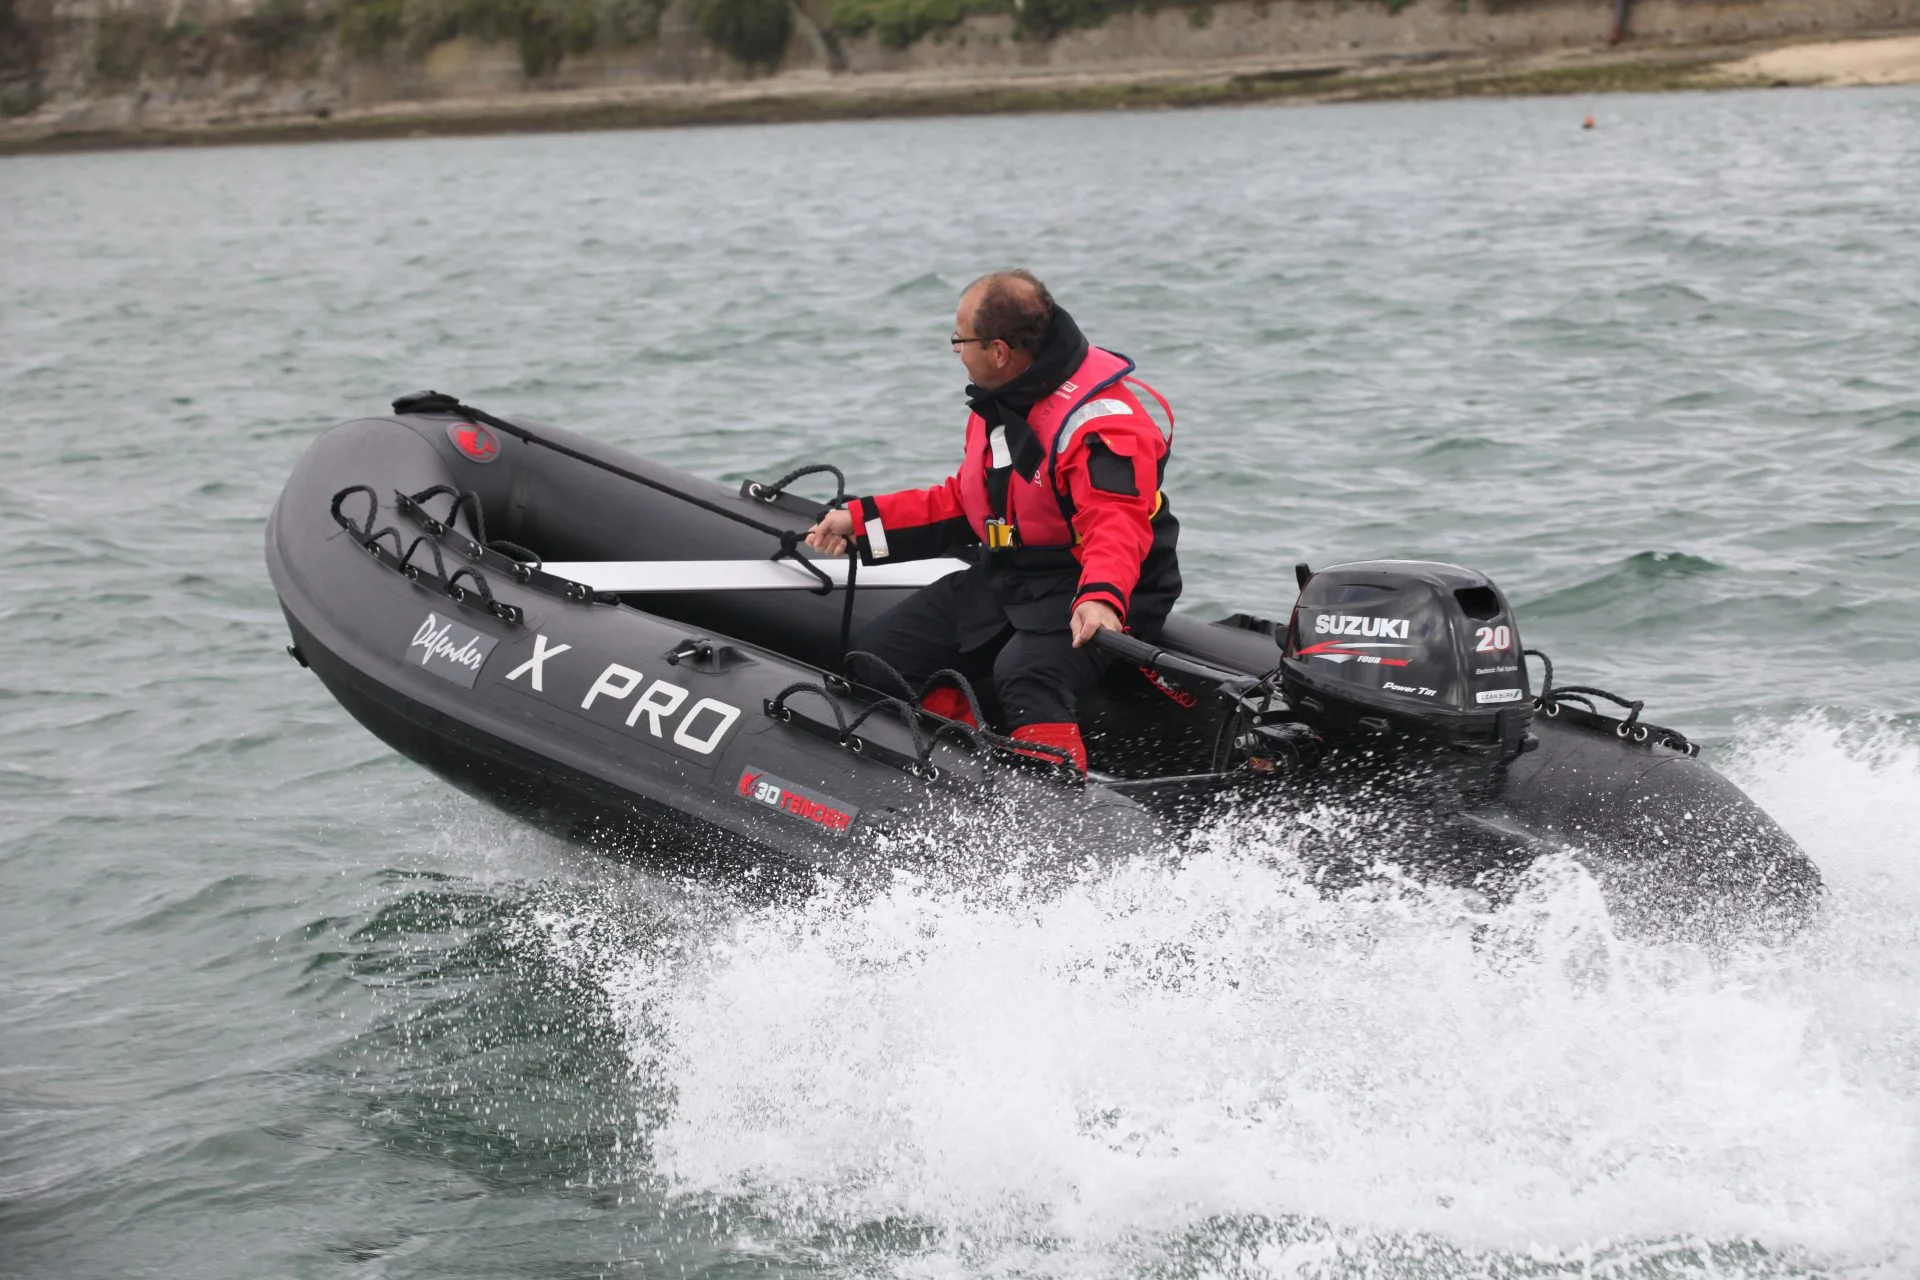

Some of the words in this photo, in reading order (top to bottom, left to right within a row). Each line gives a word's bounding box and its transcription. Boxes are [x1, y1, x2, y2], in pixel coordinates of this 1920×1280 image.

[411, 613, 482, 670] Defender
[1314, 614, 1410, 639] SUZUKI
[1475, 625, 1512, 653] 20
[505, 634, 572, 692] X
[580, 662, 741, 755] PRO
[1382, 681, 1417, 693] Power
[780, 789, 852, 833] TENDER
